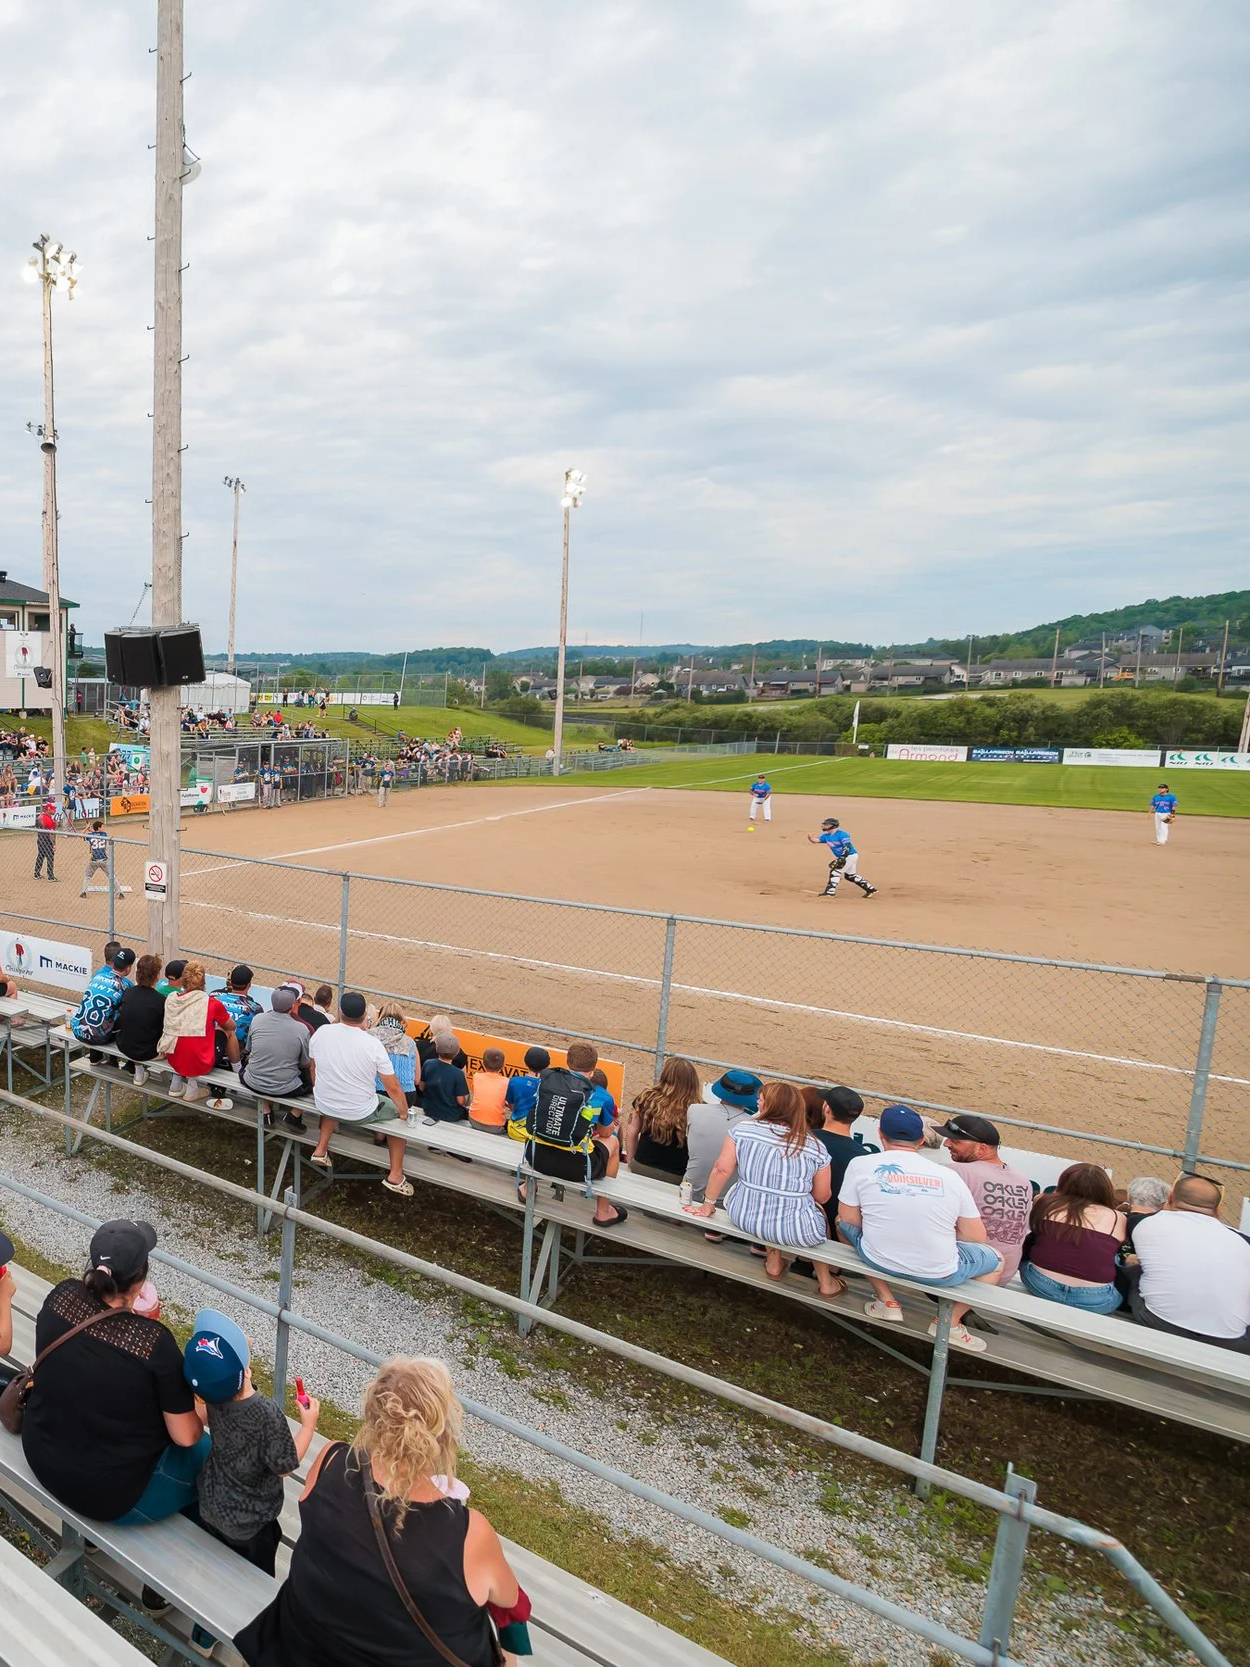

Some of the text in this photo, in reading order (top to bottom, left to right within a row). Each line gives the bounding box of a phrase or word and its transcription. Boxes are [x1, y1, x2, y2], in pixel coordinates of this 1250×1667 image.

[90, 838, 106, 849] 32
[55, 961, 88, 975] MACKIE
[545, 1094, 560, 1135] DIRECTION
[551, 1096, 568, 1137] ULTIMATE
[887, 1173, 942, 1188] QUIKSILVER
[983, 1181, 1029, 1197] OAKLEY
[983, 1193, 1029, 1210] OAKLEY
[981, 1206, 1028, 1221] OAKLEY
